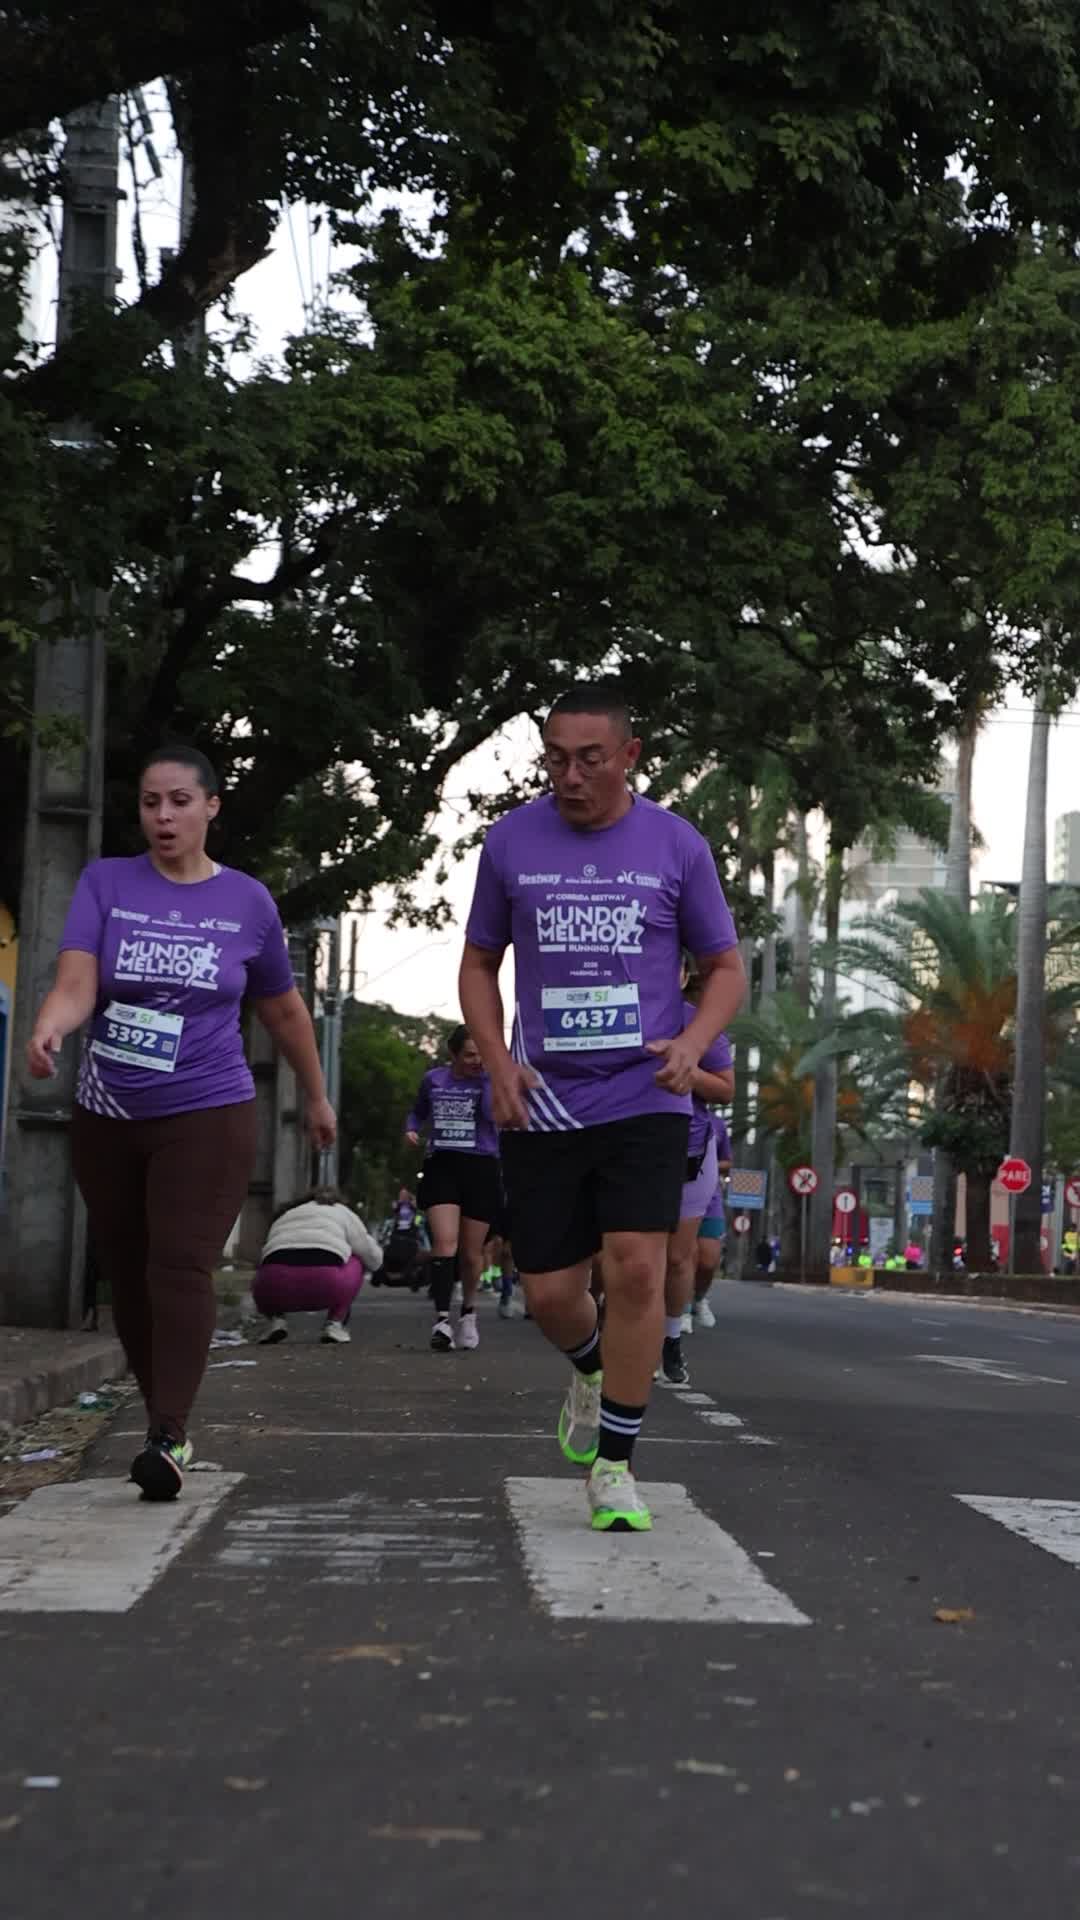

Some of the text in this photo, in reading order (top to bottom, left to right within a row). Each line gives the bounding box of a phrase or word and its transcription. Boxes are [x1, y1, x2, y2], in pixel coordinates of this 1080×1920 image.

[536, 905, 628, 925] MUNDO
[538, 925, 629, 942] MELHOR
[118, 939, 205, 960] MUNDO
[568, 944, 610, 953] RUNNING
[115, 956, 203, 978] MELHOR
[561, 1008, 618, 1029] 6437
[107, 1023, 158, 1048] 5392
[1000, 1170, 1029, 1181] PARE
